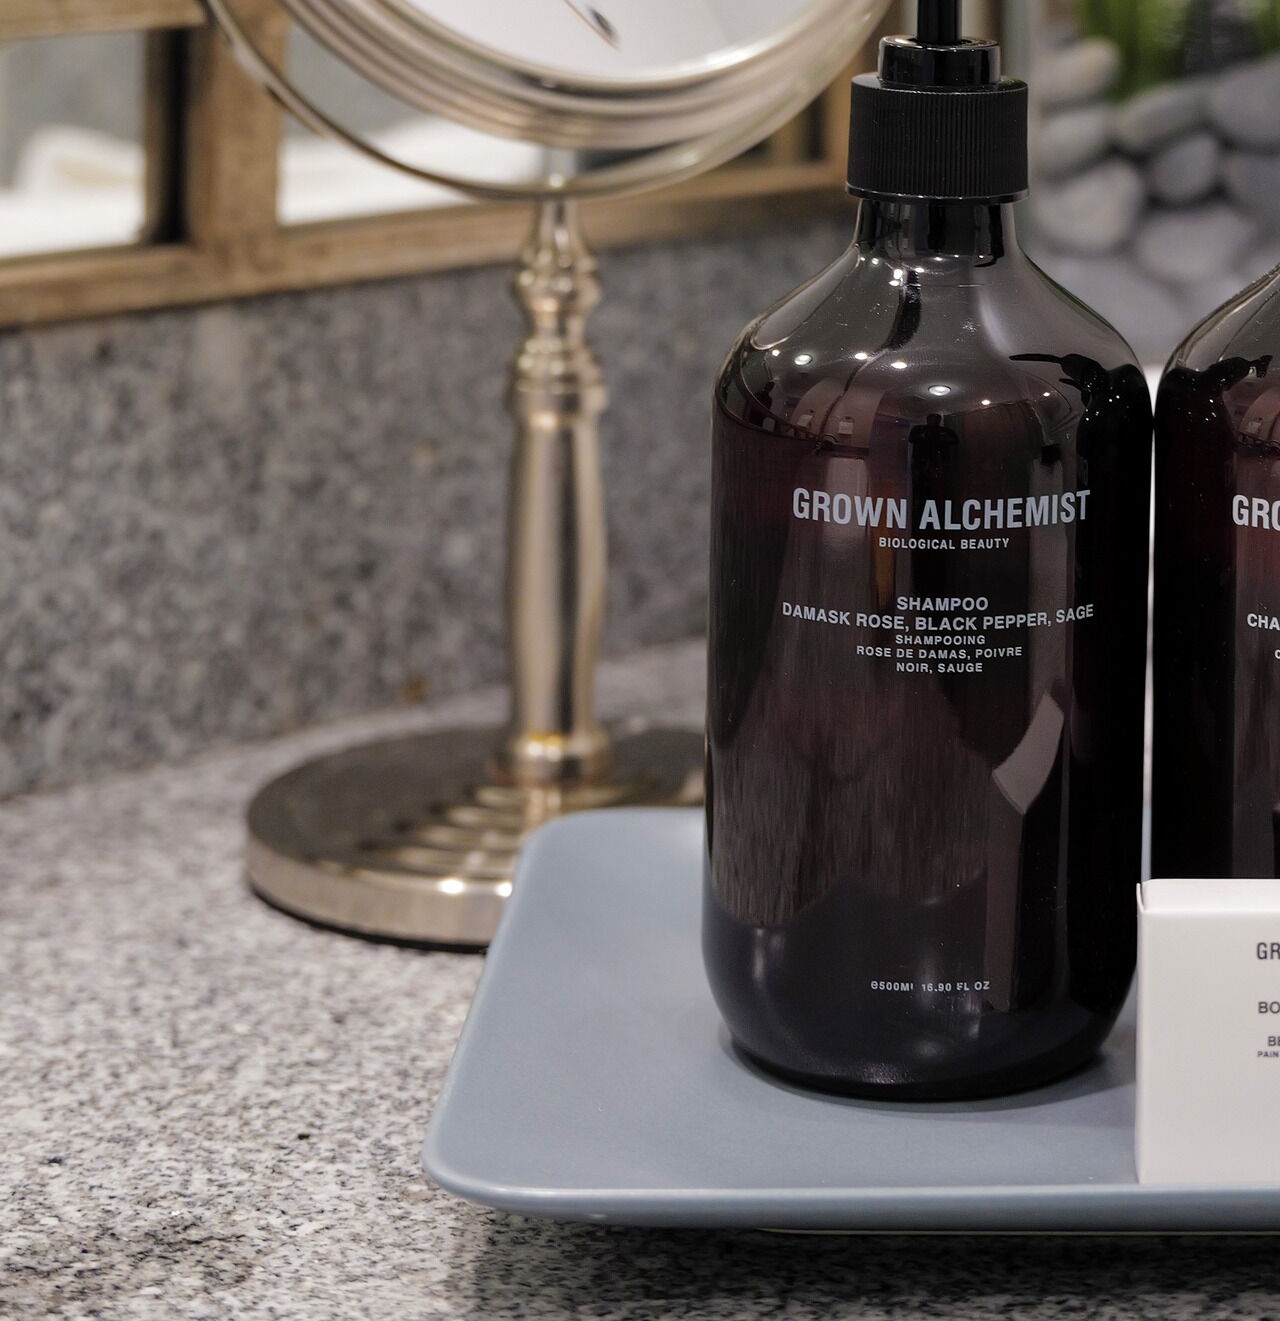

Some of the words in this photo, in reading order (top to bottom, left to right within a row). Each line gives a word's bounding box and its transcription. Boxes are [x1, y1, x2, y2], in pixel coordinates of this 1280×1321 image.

[792, 487, 908, 530] GROWN
[918, 489, 1091, 531] ALCHEMIST
[878, 536, 956, 550] BIOLOGICAL
[960, 537, 1010, 550] BEAUTY
[896, 595, 989, 612] SHAMPOO
[782, 601, 852, 626] DAMASK
[855, 612, 910, 633] ROSE,
[914, 616, 978, 632] BLACK
[982, 611, 1052, 631] PEPPER,
[1055, 603, 1095, 624] SAGE
[894, 633, 986, 646] SHAMPOOING
[856, 645, 892, 658] ROSE
[895, 647, 914, 659] DE
[918, 648, 971, 661] DAMAS,
[975, 646, 1023, 659] POIVRE
[896, 661, 933, 675] NOIR,
[937, 662, 983, 674] SAUGE
[921, 981, 952, 992] 16.90
[973, 980, 991, 991] OZ
[1257, 1050, 1279, 1059] PAIN
